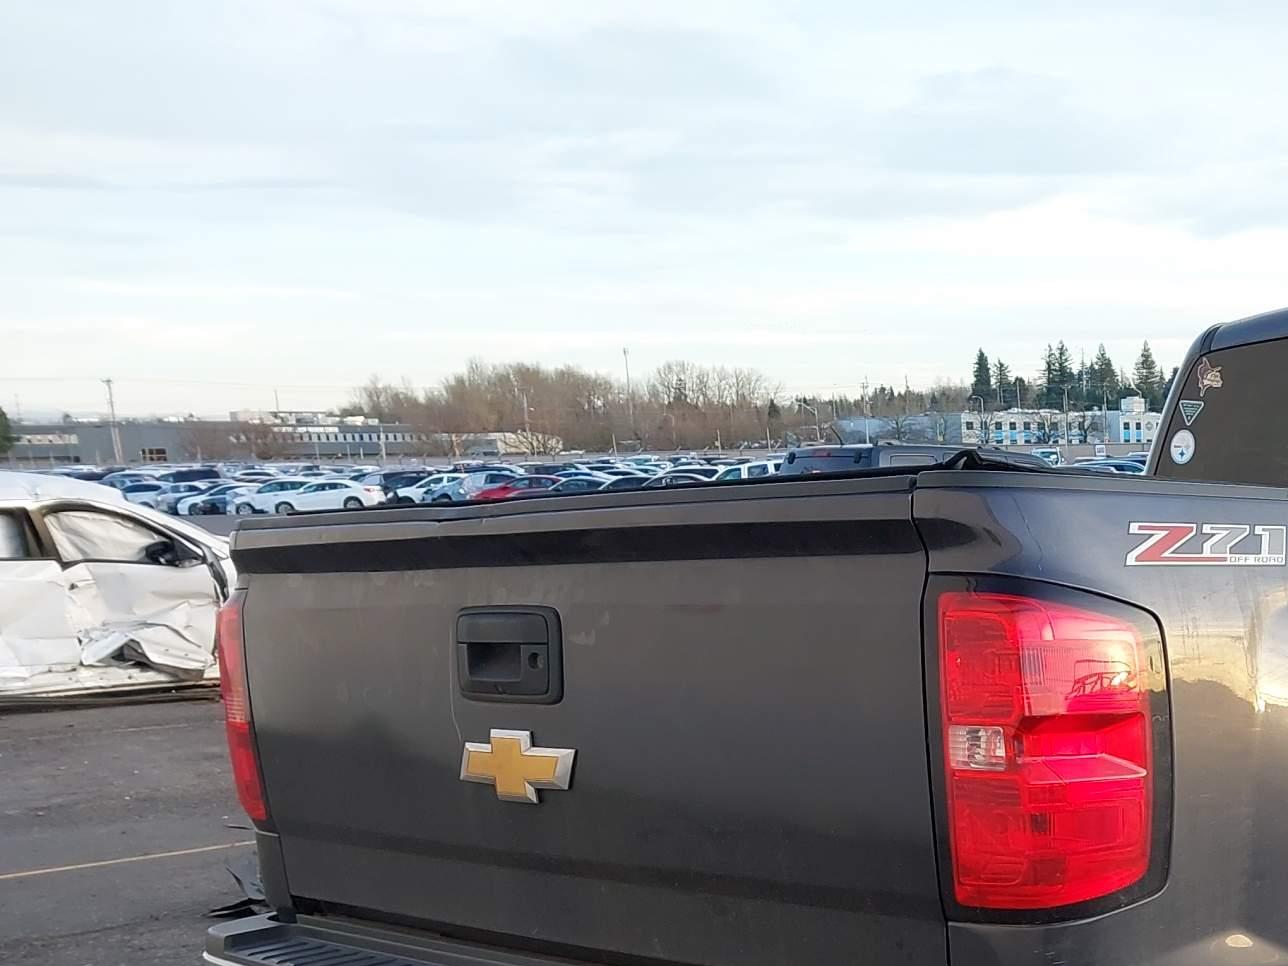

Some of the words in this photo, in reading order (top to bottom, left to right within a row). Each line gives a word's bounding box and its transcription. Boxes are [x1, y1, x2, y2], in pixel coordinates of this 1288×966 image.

[1124, 521, 1287, 567] Z71
[1229, 556, 1251, 564] OFF
[1254, 556, 1284, 564] ROAD
